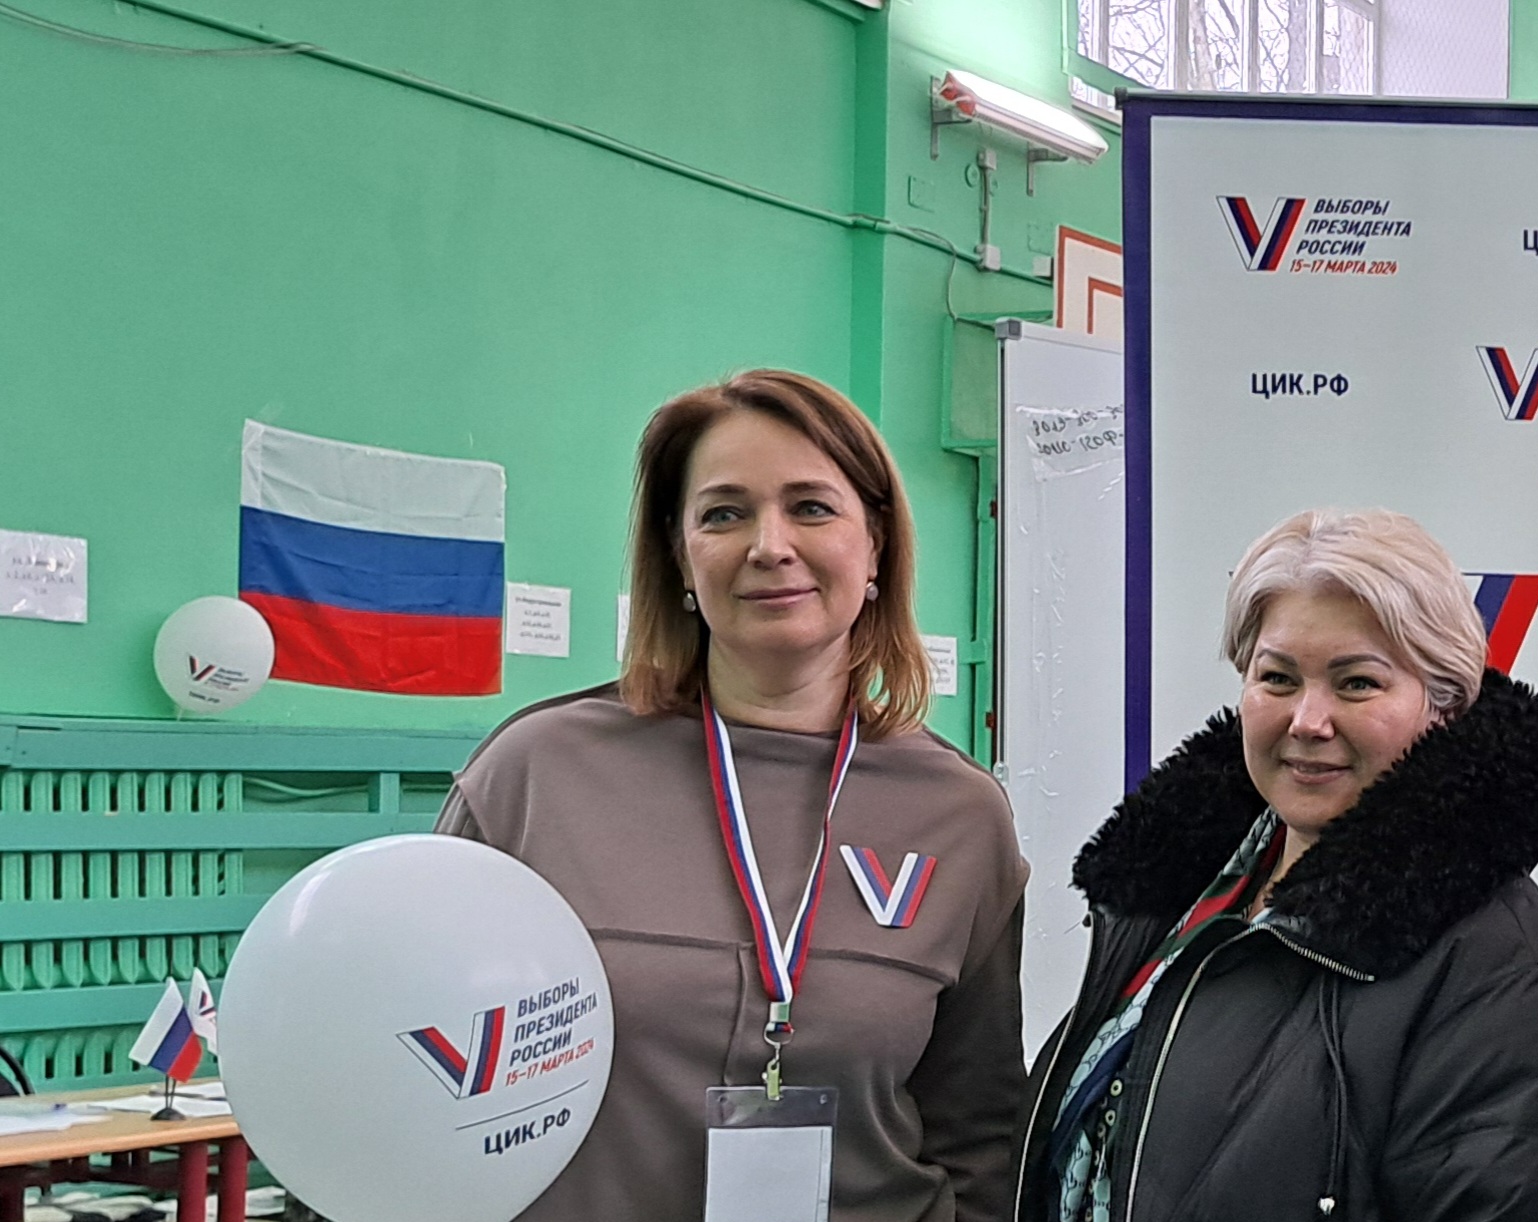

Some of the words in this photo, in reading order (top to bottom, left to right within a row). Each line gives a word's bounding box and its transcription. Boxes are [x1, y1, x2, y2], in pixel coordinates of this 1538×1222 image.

[1312, 198, 1391, 216] ВЫБОРЫ
[1304, 219, 1412, 238] ПРЕЗИДЕНТА
[1296, 239, 1365, 257] РОССИИ
[1326, 260, 1365, 274] МАРТА
[1367, 261, 1398, 275] 2024
[1251, 372, 1349, 399] ЦИК.РФ
[517, 977, 579, 1018] ВЫБОРЫ
[513, 992, 598, 1043] ПРЕЗИДЕНТА
[509, 1028, 572, 1067] РОССИИ
[539, 1049, 575, 1075] МАРТА
[484, 1107, 571, 1155] ЦИК.РФ
